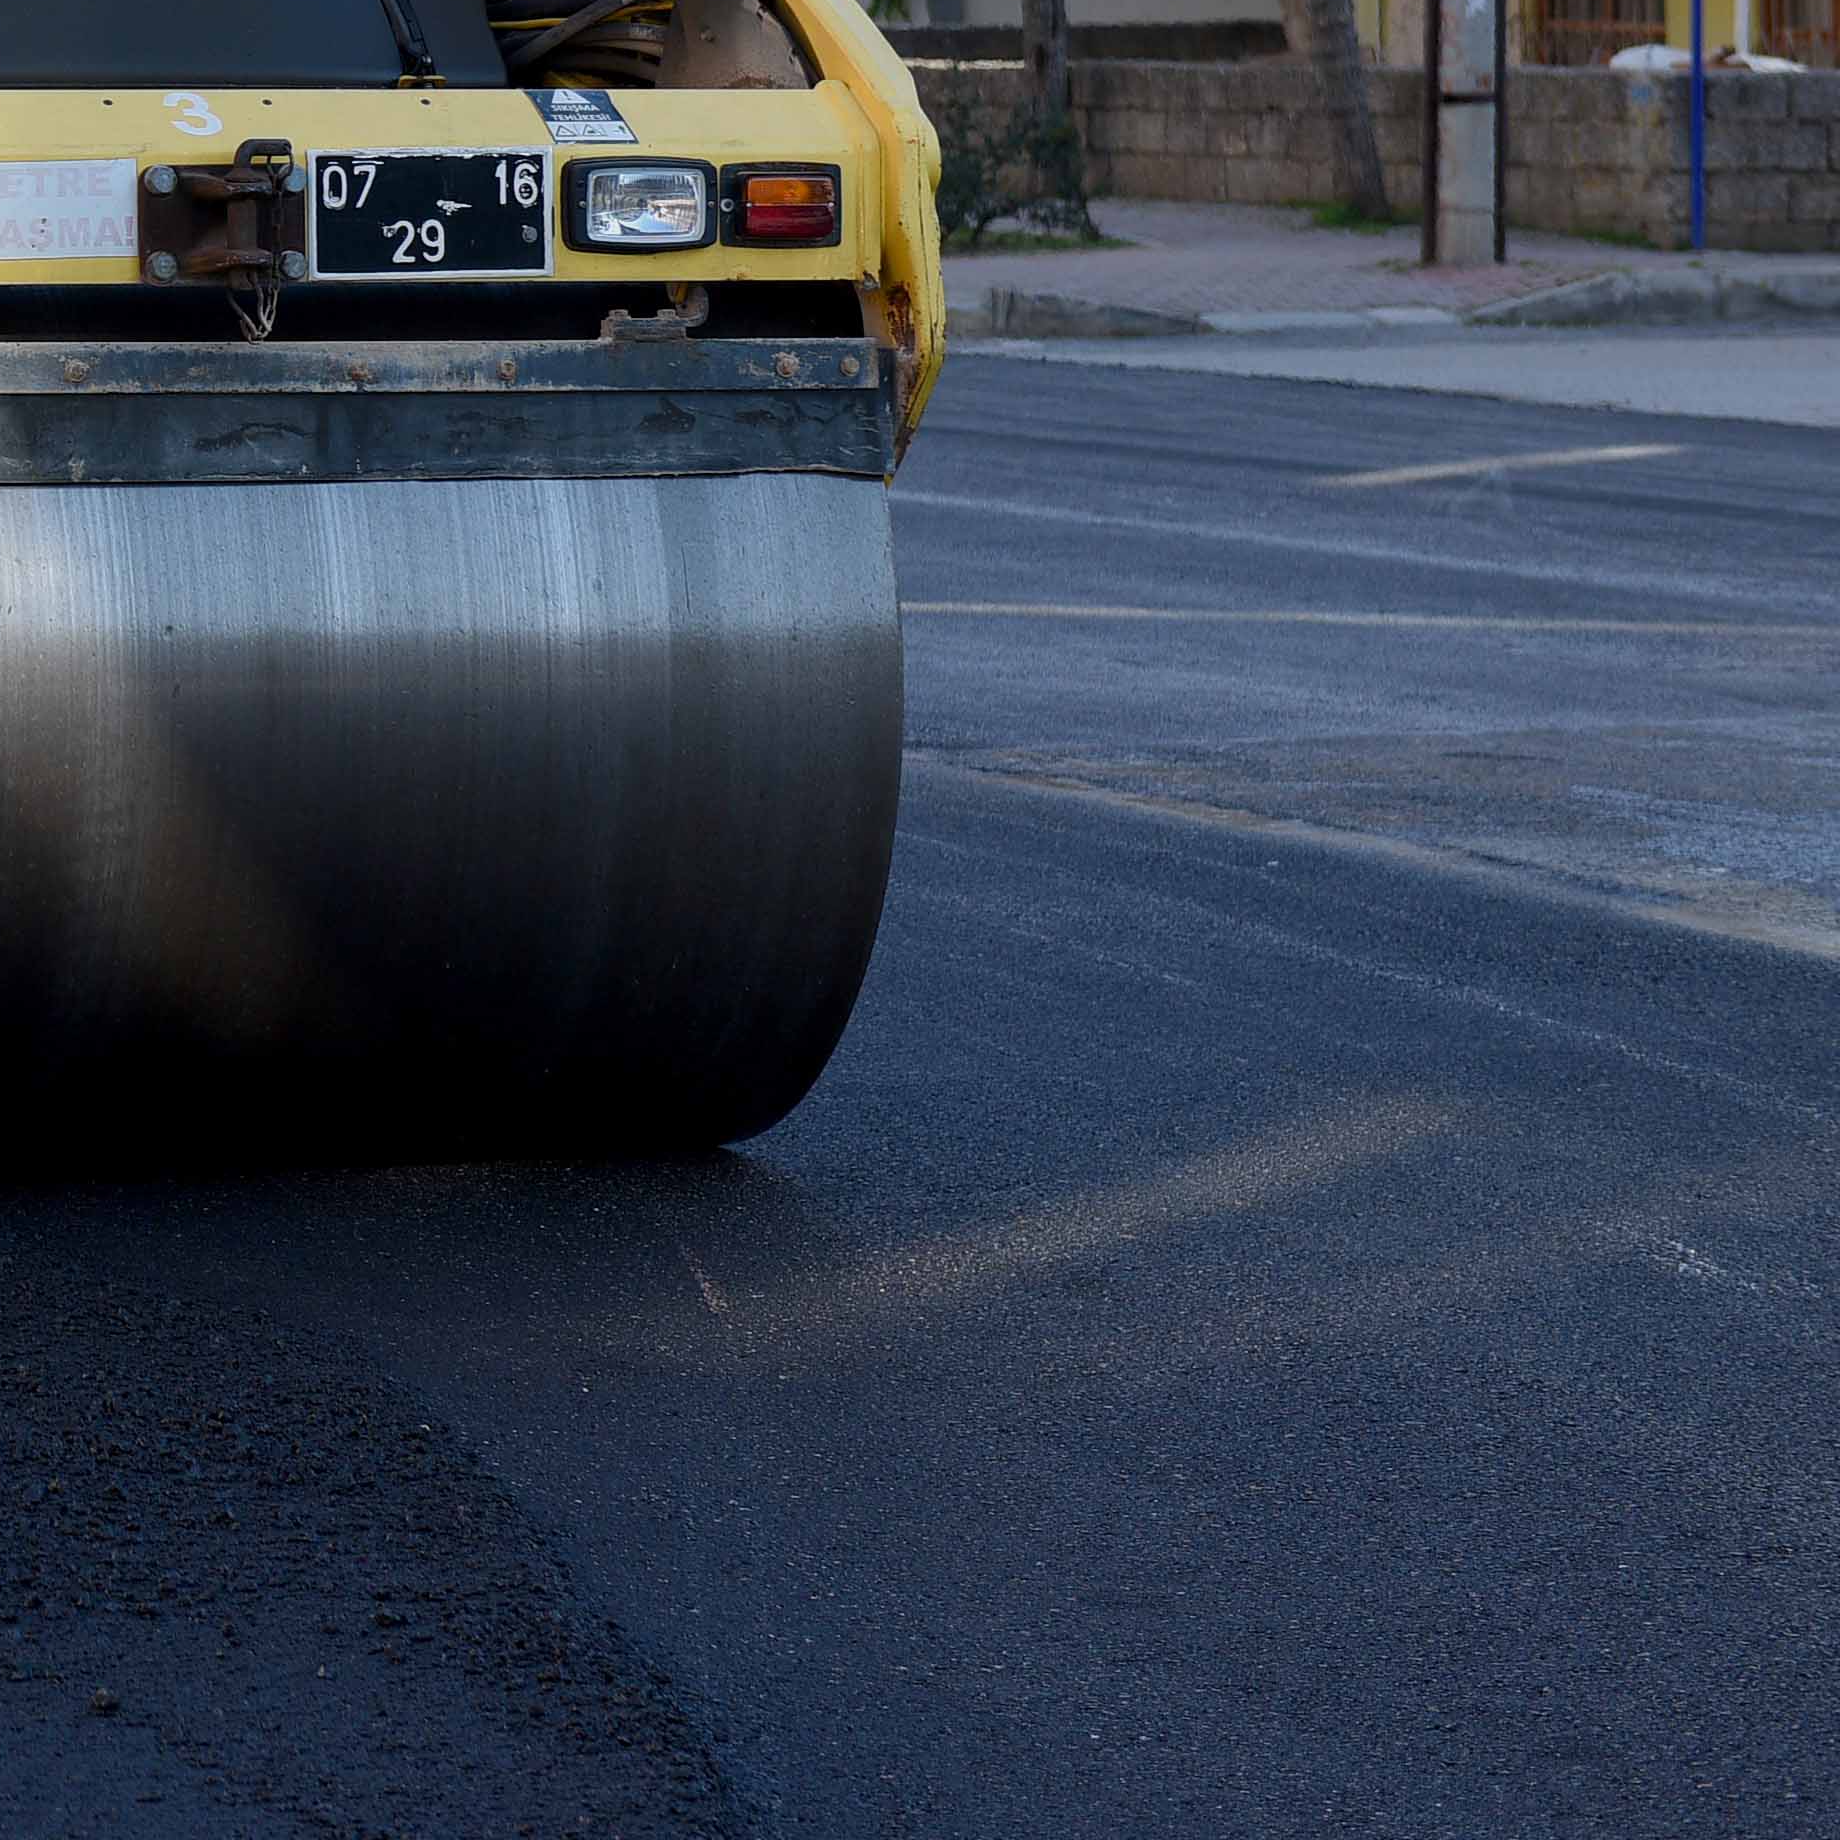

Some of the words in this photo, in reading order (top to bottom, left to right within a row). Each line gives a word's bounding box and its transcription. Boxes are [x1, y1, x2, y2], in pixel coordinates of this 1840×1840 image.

[162, 92, 223, 136] 3
[322, 163, 377, 210] 07
[494, 160, 539, 208] 16
[390, 218, 446, 263] 29
